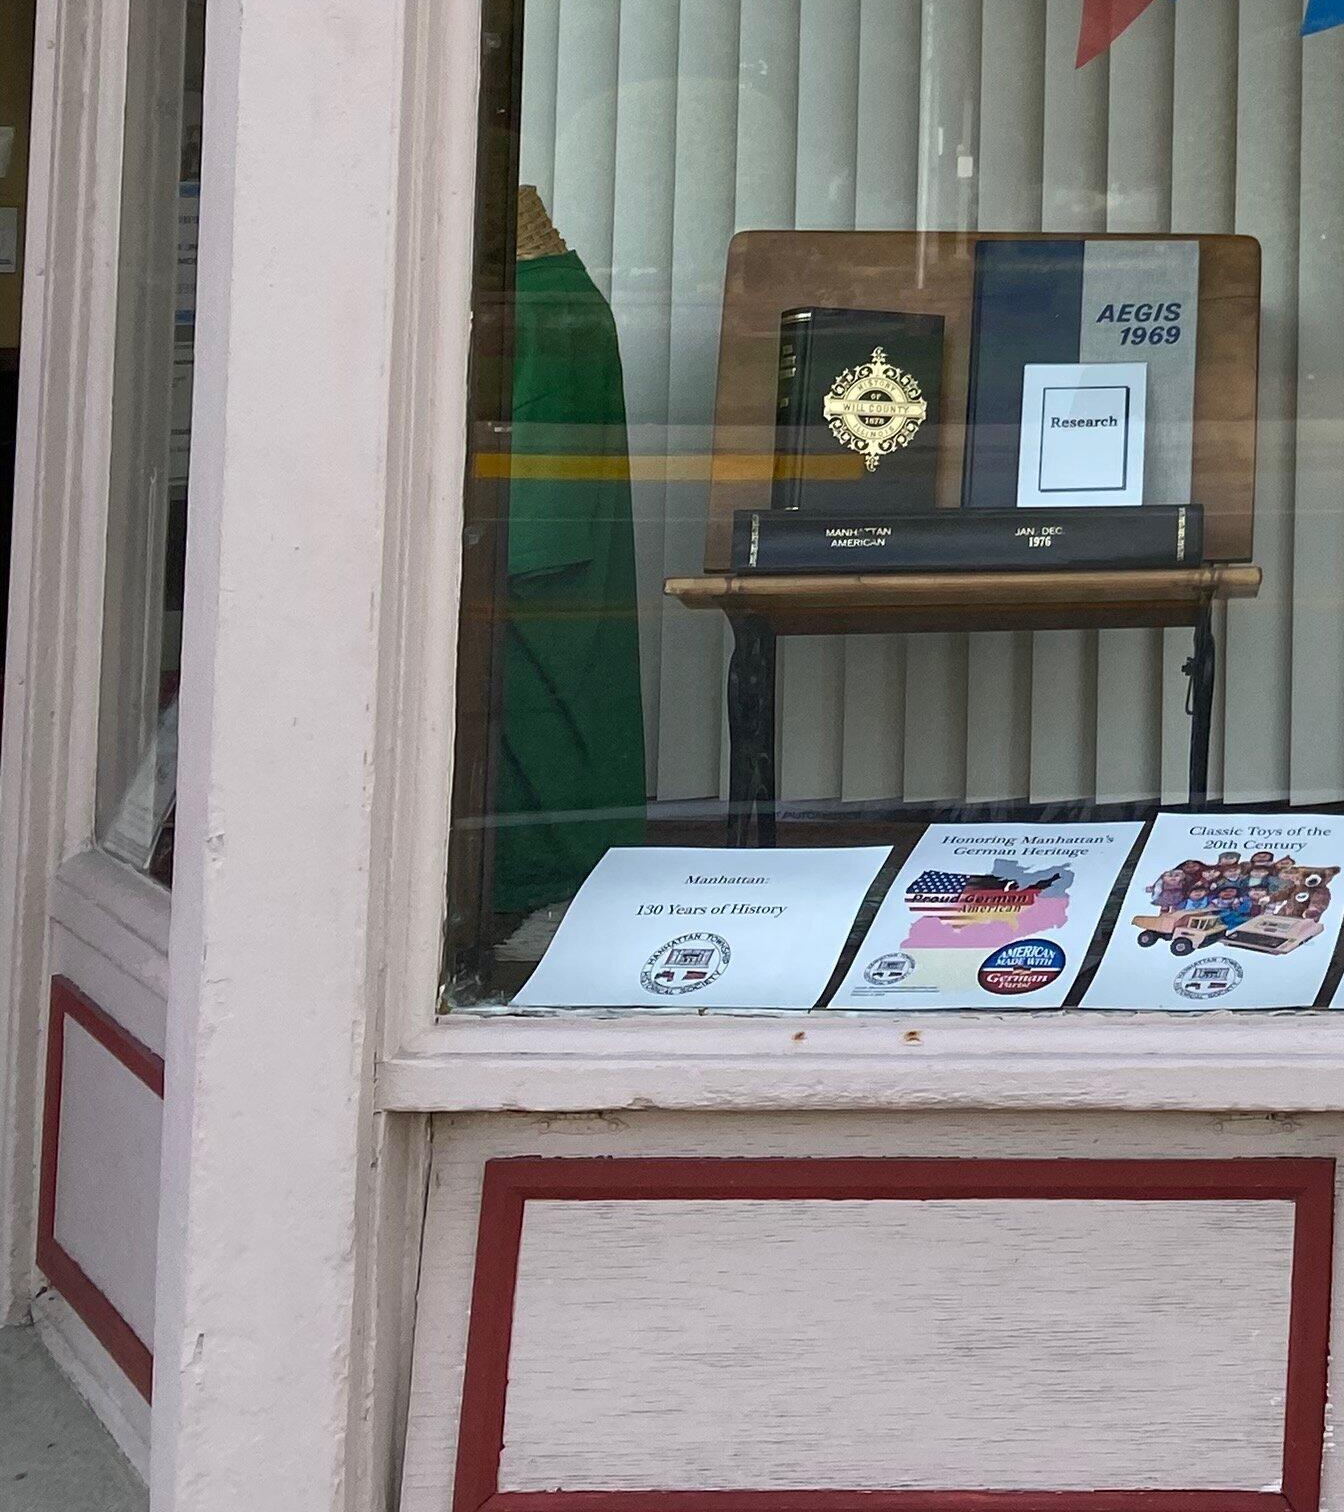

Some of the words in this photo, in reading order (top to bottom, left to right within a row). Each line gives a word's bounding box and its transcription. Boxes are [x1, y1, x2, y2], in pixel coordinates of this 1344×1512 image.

[1096, 303, 1182, 323] AEGIS
[1120, 326, 1182, 346] 1969
[858, 379, 896, 391] HISTORY
[843, 403, 865, 412] WILL
[869, 404, 910, 414] COUNTY
[1051, 416, 1118, 429] Research
[854, 423, 896, 438] ILLINOIS
[826, 527, 892, 537] MANHTAN
[831, 538, 885, 547] AMERICAN
[1028, 536, 1052, 547] 1976
[1189, 826, 1243, 836] Classic
[1248, 826, 1282, 839] Toys
[1287, 826, 1306, 836] of
[1307, 826, 1332, 836] the
[941, 835, 1015, 847] Honoring
[1021, 834, 1114, 844] Manhattan's
[1203, 840, 1238, 850] 20th
[1243, 840, 1307, 852] Century
[953, 847, 1016, 855] German
[1021, 847, 1089, 858] Heritage
[684, 875, 770, 885] Manhattan:
[911, 893, 961, 903] Proud
[964, 893, 1027, 903] German
[635, 904, 664, 916] 130
[667, 904, 706, 915] Years
[710, 904, 731, 915] of
[730, 903, 788, 919] History
[958, 904, 1021, 913] American
[999, 946, 1056, 959] AMERICAN
[995, 957, 1025, 966] MADE
[986, 973, 1048, 983] German
